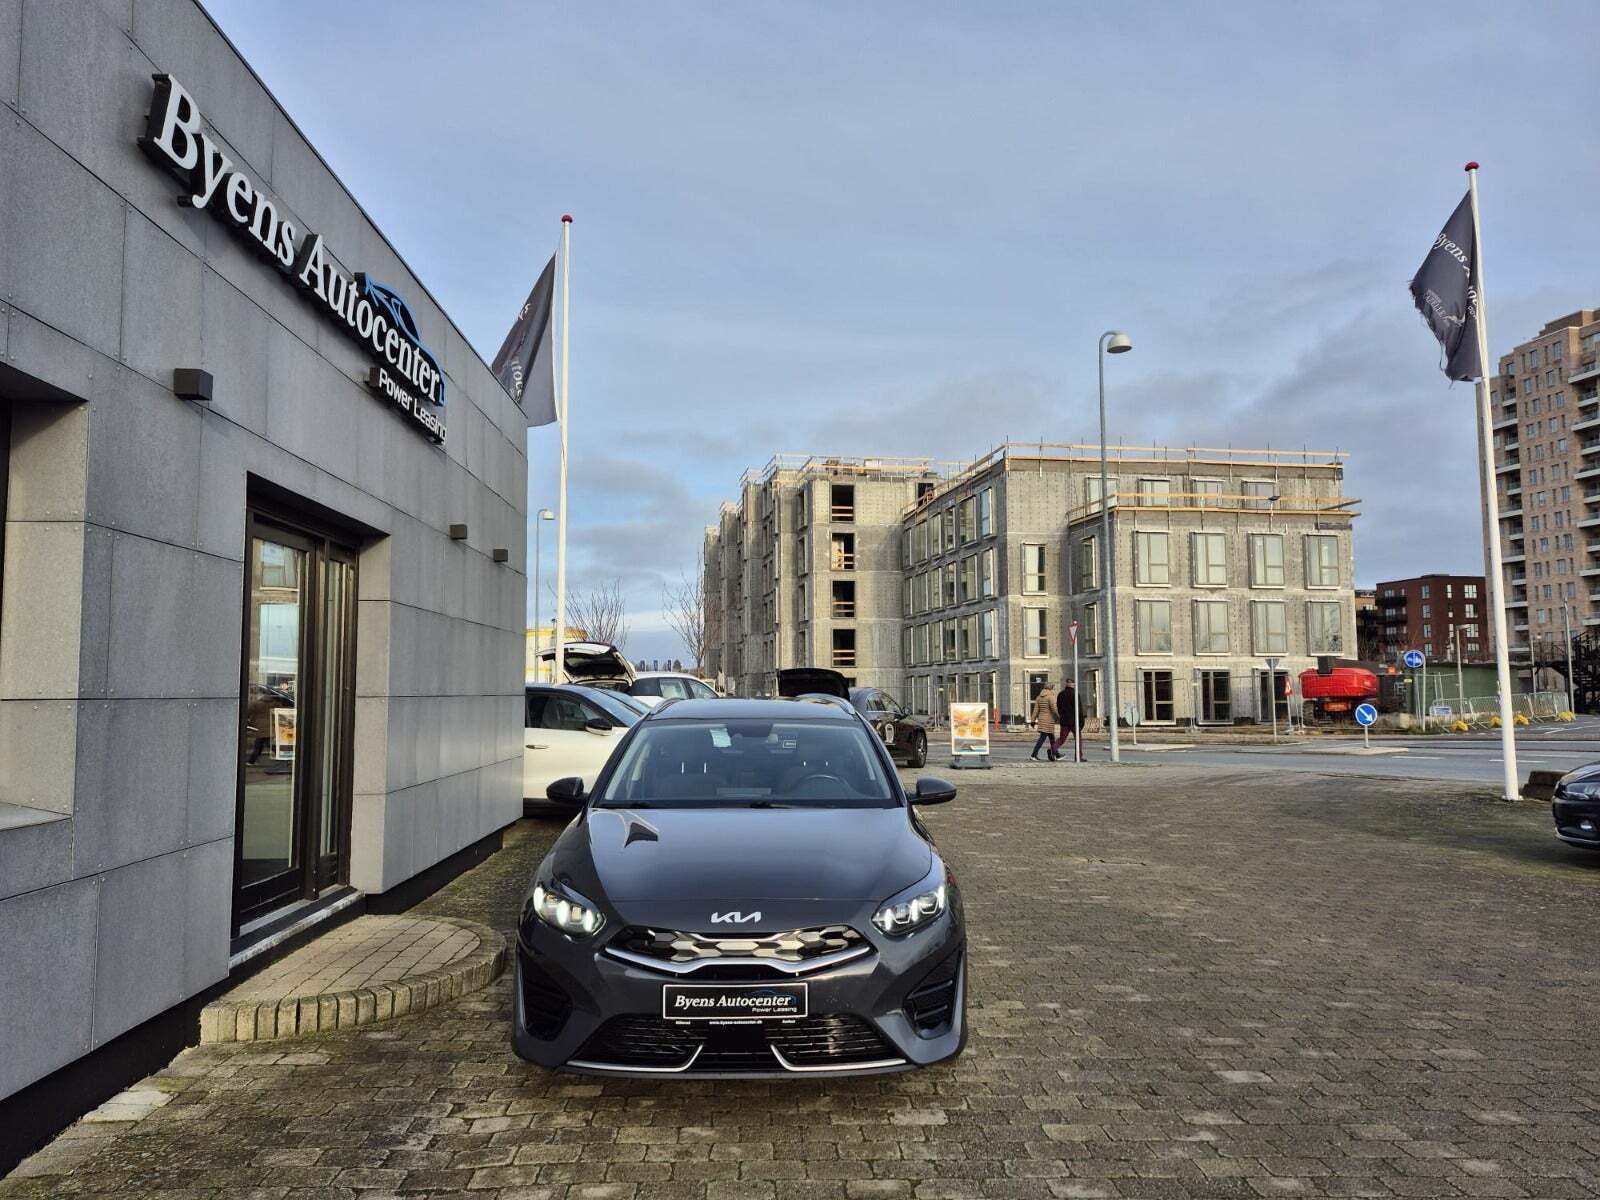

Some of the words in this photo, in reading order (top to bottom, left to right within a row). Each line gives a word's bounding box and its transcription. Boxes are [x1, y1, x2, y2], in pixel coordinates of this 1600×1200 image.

[153, 74, 297, 266] Byens
[299, 234, 440, 402] Autocenter
[379, 367, 413, 411] Power
[414, 398, 447, 445] Leasing
[674, 995, 715, 1010] Byens
[716, 995, 792, 1007] Autocenter
